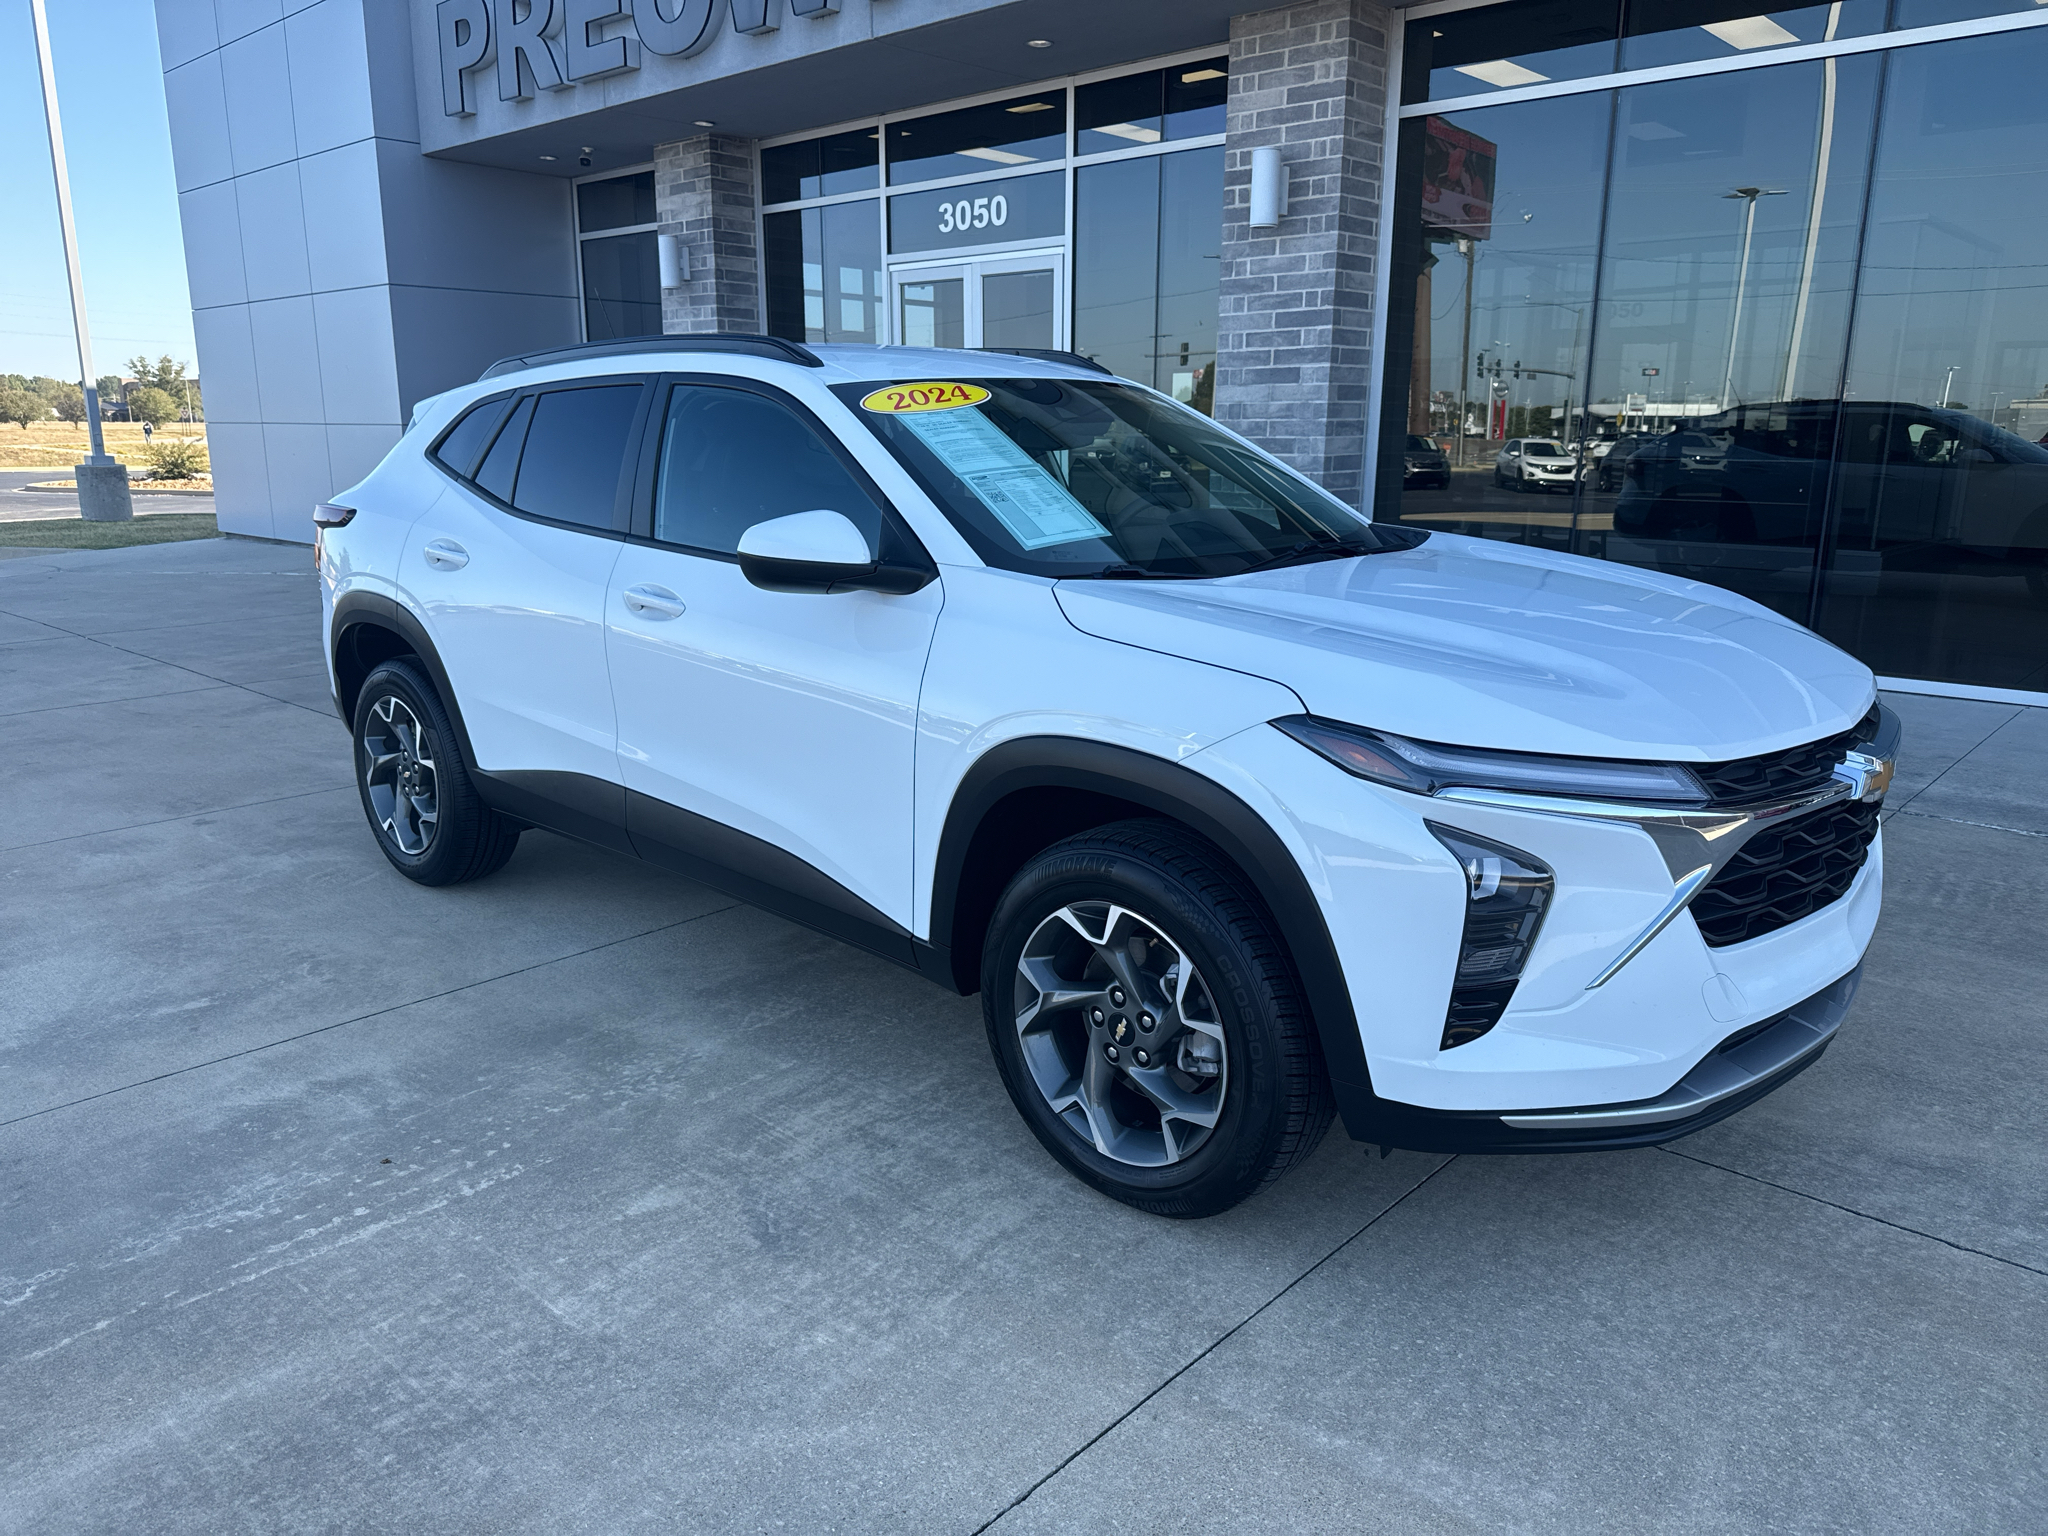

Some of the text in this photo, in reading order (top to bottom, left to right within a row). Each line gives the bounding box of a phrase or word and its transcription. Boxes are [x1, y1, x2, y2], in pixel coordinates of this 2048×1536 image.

[938, 195, 1008, 233] 3050
[886, 384, 973, 410] 2024
[1051, 855, 1118, 875] MOHAVE
[1216, 954, 1265, 1110] CROSSOVER
